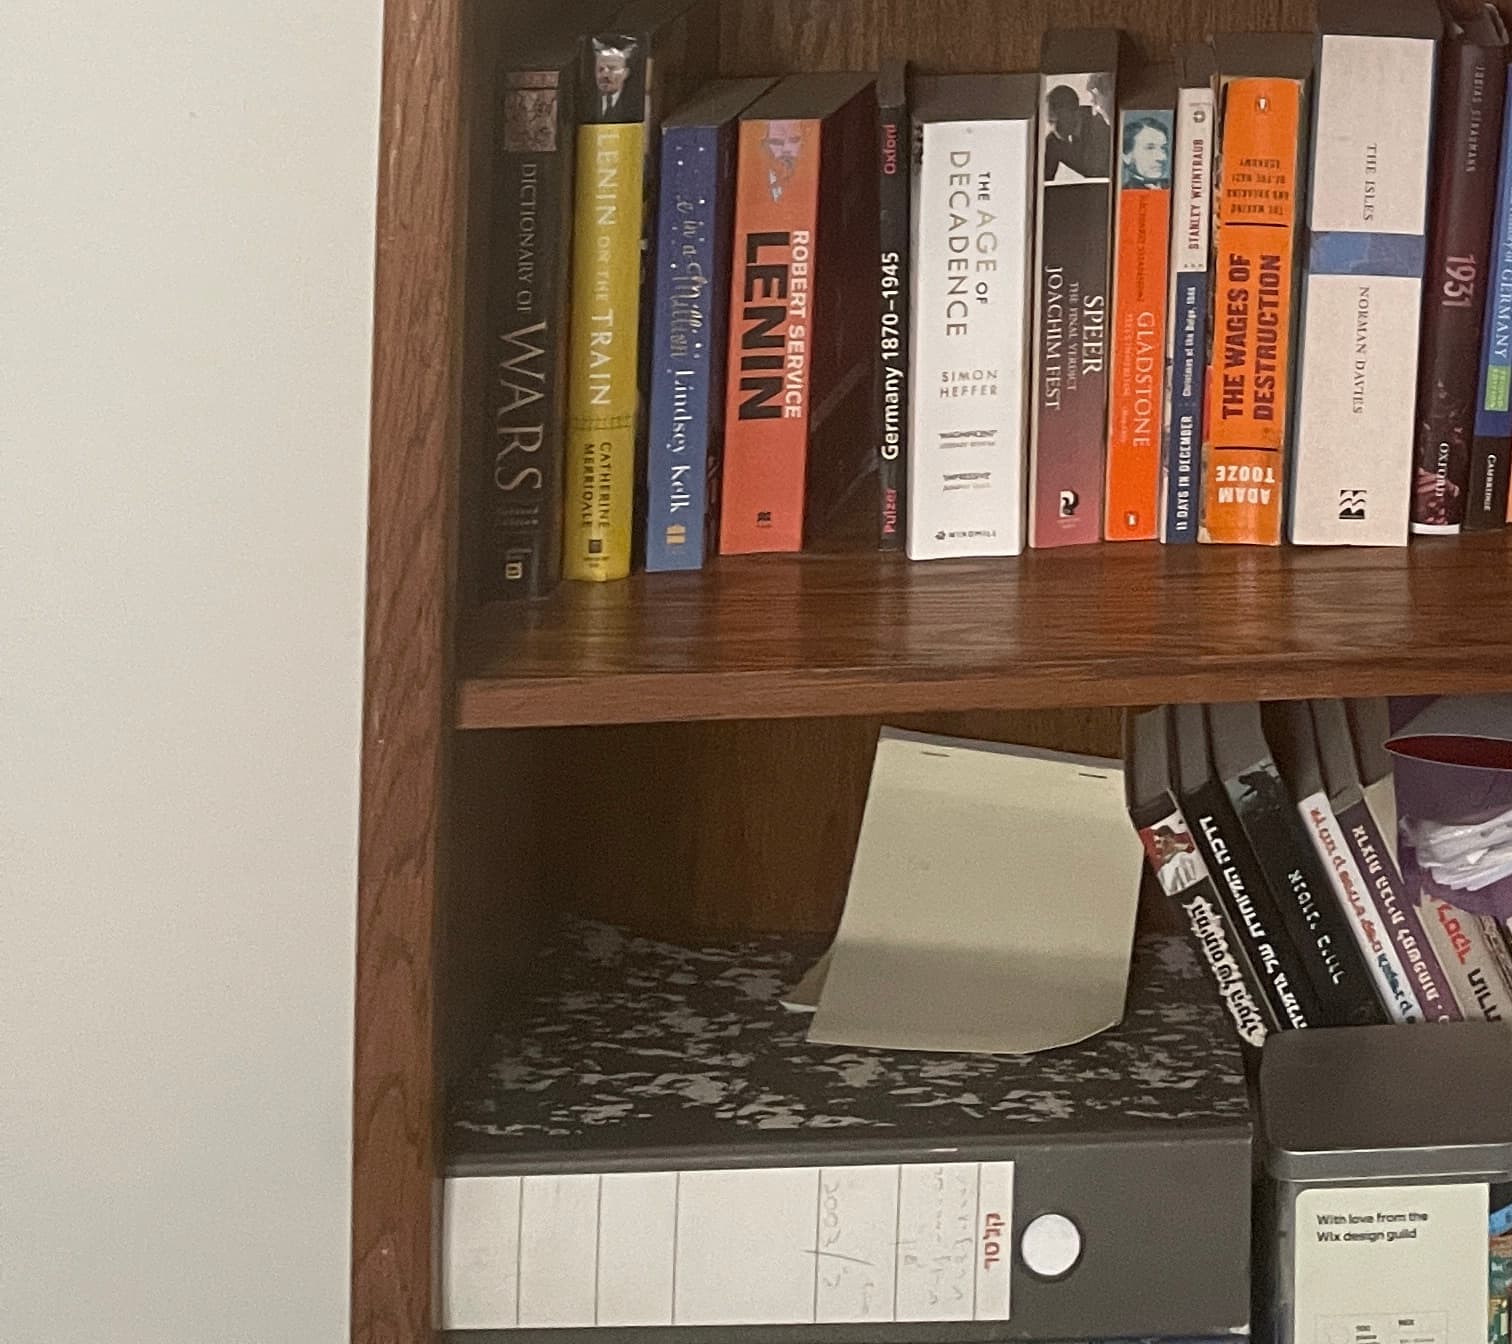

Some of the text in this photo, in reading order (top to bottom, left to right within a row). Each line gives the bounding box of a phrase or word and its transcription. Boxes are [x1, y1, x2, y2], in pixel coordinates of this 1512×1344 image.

[946, 151, 970, 336] DECADENCE
[976, 172, 997, 303] THE AGE OF
[1363, 145, 1376, 221] THE ISLES
[738, 232, 790, 421] LENIN
[783, 231, 809, 418] ROBERT SERVICE
[942, 369, 997, 382] SIMON
[1221, 253, 1251, 420] THE WAGES OF
[1253, 254, 1280, 421] DESTRUCTION
[1352, 287, 1370, 414] NORMAN DAVIES
[880, 364, 904, 460] Germany
[940, 385, 997, 398] HEFFER
[1317, 1229, 1416, 1243] Wix design guild
[1376, 1214, 1406, 1223] from
[1409, 1212, 1427, 1222] the
